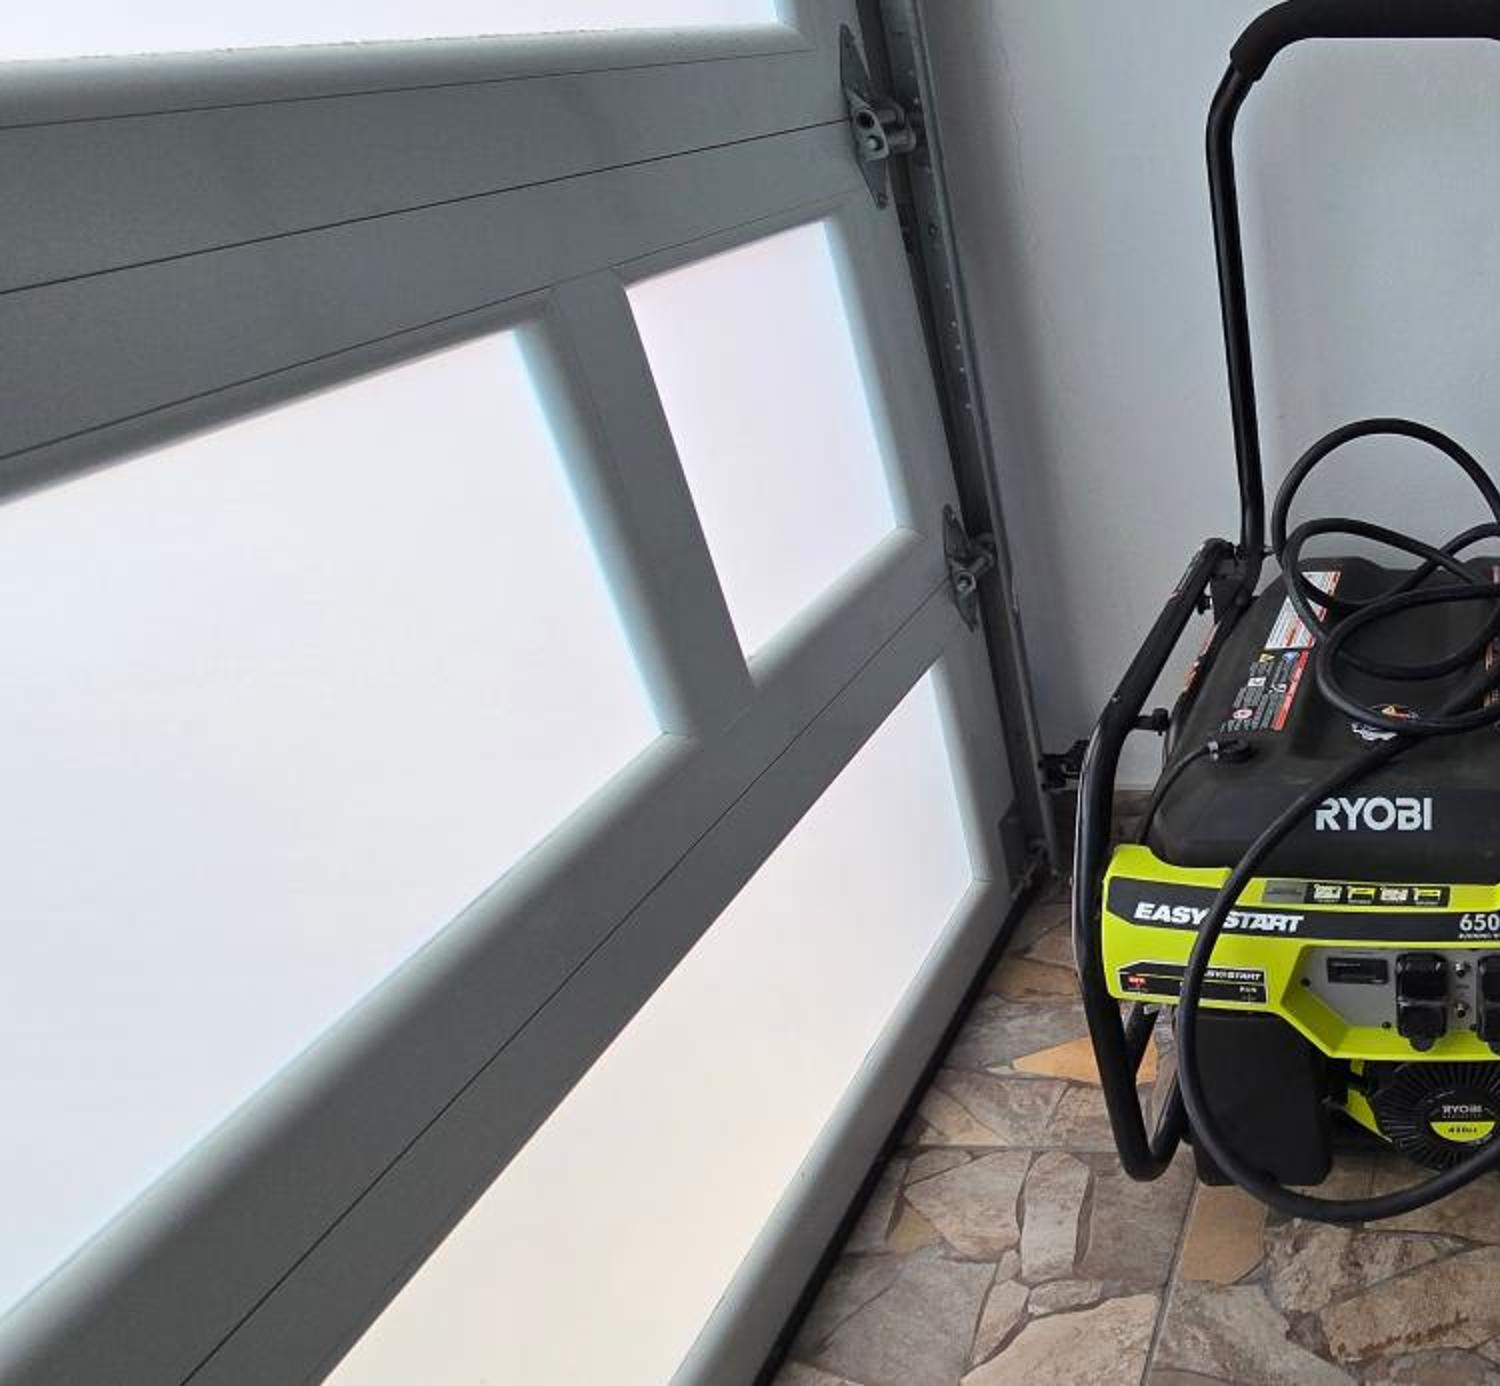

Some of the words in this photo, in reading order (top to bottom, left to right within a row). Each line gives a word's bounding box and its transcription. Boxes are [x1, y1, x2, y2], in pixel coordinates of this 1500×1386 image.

[1315, 797, 1433, 831] RYOBI
[1133, 901, 1210, 925] EASY
[1222, 911, 1304, 933] START
